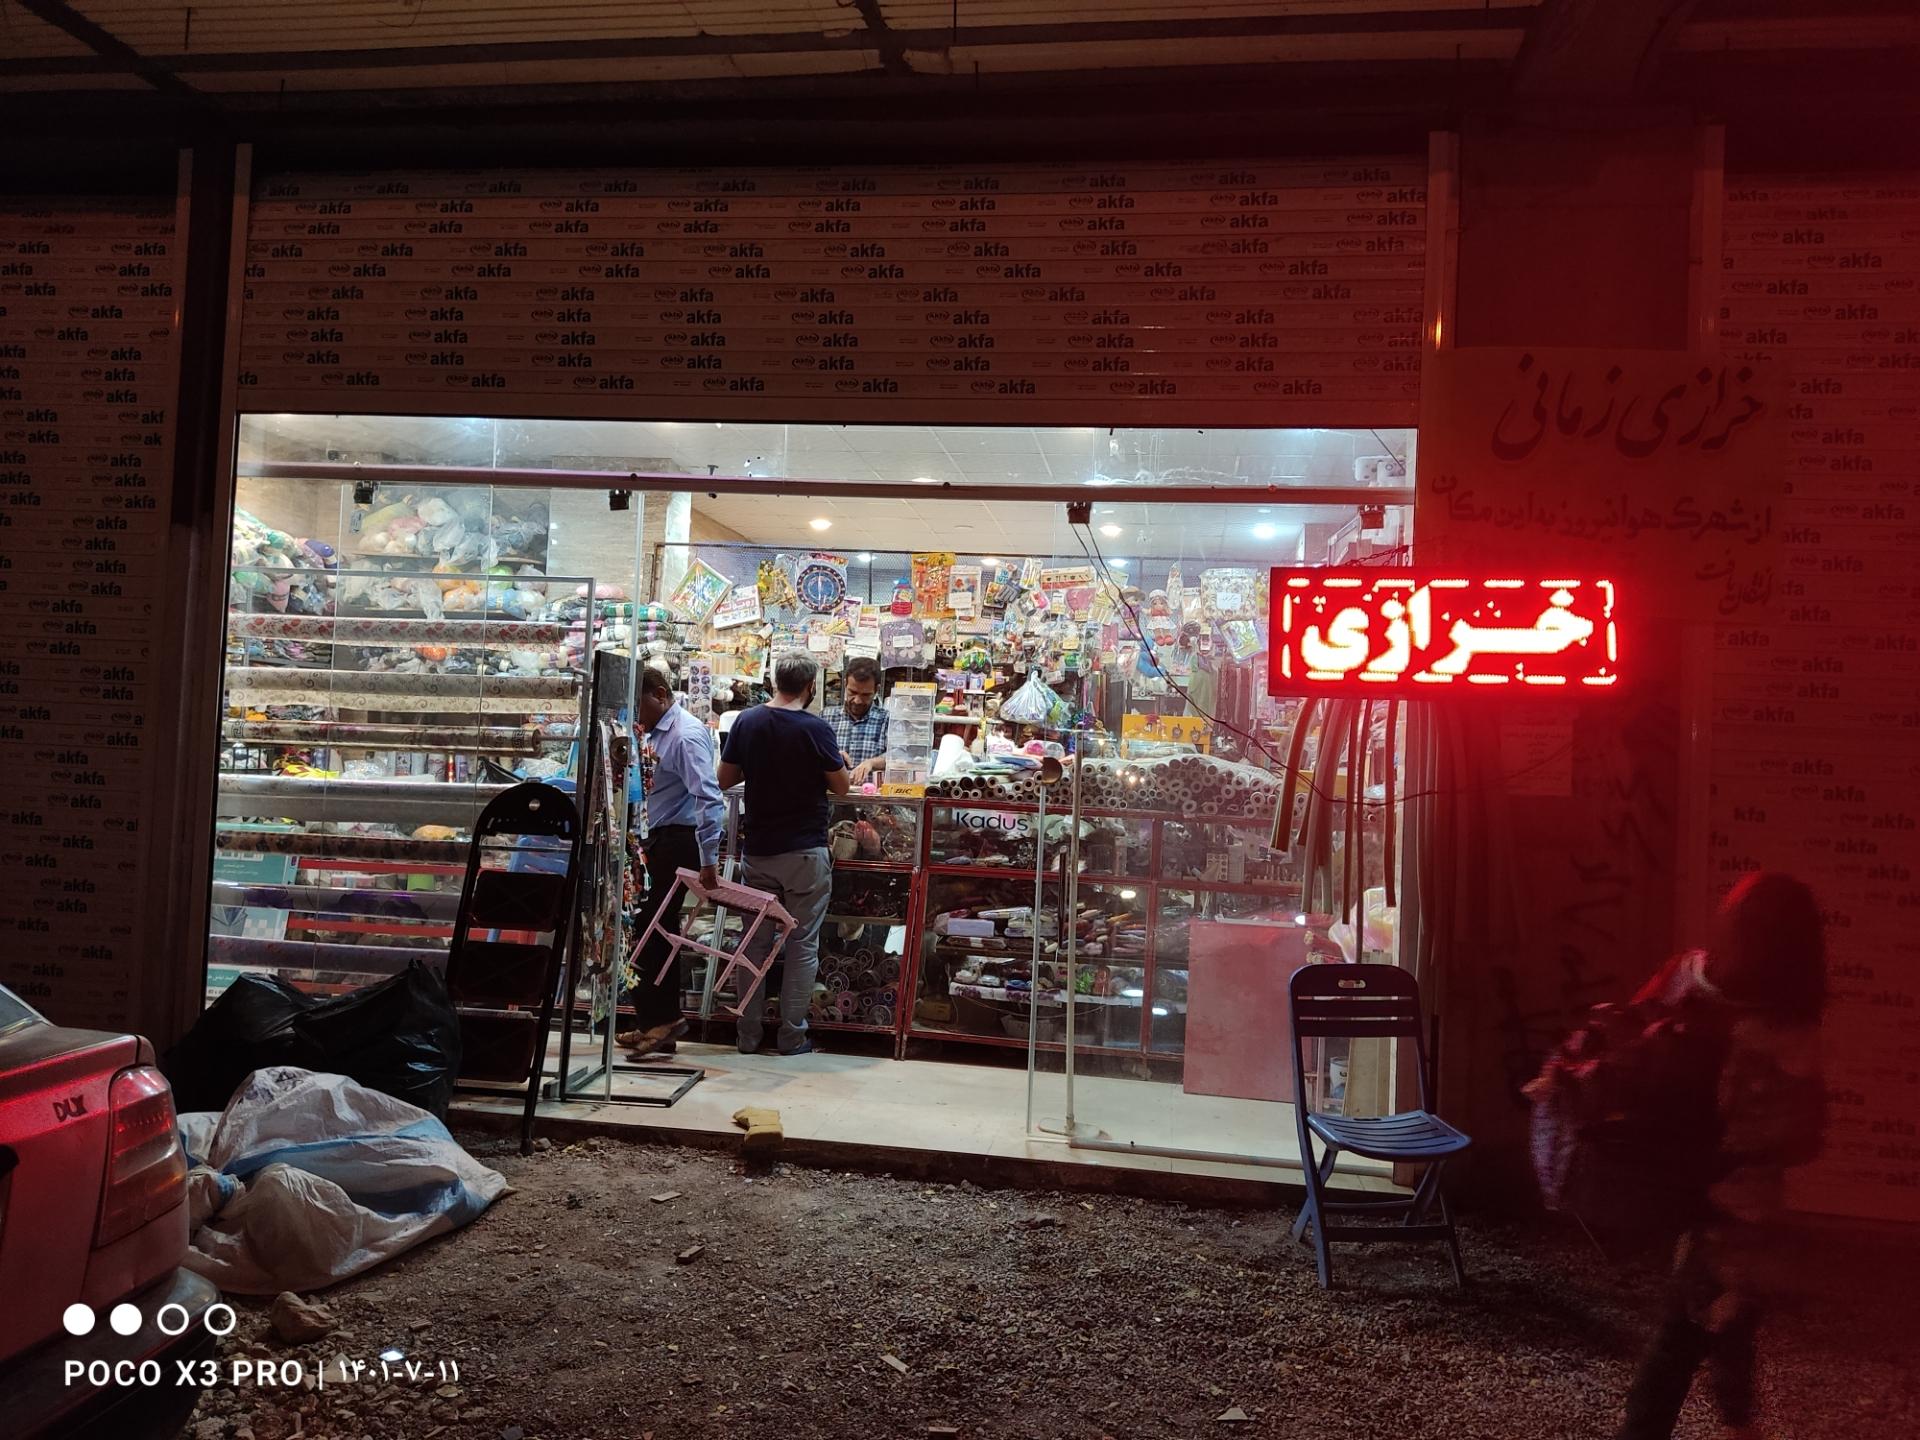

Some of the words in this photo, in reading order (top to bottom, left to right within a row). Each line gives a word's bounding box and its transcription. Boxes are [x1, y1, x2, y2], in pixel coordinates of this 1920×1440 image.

[565, 199, 599, 212] akfa
[694, 199, 728, 212] akfa
[825, 198, 860, 212] akfa
[959, 197, 996, 211] akfa
[1097, 194, 1135, 209] akfa
[1239, 192, 1278, 206] akfa
[319, 201, 351, 214] akfa
[440, 200, 473, 213] akfa
[949, 218, 986, 232] akfa
[1087, 217, 1125, 230] akfa
[1230, 214, 1268, 228] akfa
[1377, 211, 1417, 225] akfa
[308, 222, 340, 234] akfa
[429, 221, 463, 233] akfa
[554, 220, 589, 233] akfa
[683, 220, 720, 233] akfa
[814, 220, 850, 233] akfa
[19, 241, 50, 254] akfa
[134, 243, 166, 255] akfa
[272, 244, 302, 257] akfa
[381, 244, 413, 257] akfa
[495, 242, 527, 256] akfa
[611, 243, 644, 257] akfa
[729, 244, 763, 257] akfa
[850, 243, 885, 258] akfa
[974, 242, 1009, 257] akfa
[1100, 240, 1137, 255] akfa
[1230, 238, 1268, 254] akfa
[1366, 236, 1404, 252] akfa
[2, 263, 33, 276] akfa
[119, 264, 150, 276] akfa
[353, 264, 386, 277] akfa
[477, 264, 511, 277] akfa
[605, 264, 639, 278] akfa
[735, 264, 770, 278] akfa
[868, 264, 904, 279] akfa
[1004, 263, 1041, 278] akfa
[1144, 262, 1182, 277] akfa
[1288, 259, 1328, 275] akfa
[25, 283, 56, 296] akfa
[141, 283, 172, 297] akfa
[332, 287, 363, 300] akfa
[445, 287, 478, 300] akfa
[561, 287, 594, 301] akfa
[680, 289, 714, 302] akfa
[800, 289, 834, 303] akfa
[923, 288, 958, 302] akfa
[1048, 287, 1085, 302] akfa
[1178, 286, 1216, 301] akfa
[1312, 284, 1351, 300] akfa
[91, 306, 123, 319] akfa
[307, 307, 339, 320] akfa
[430, 307, 464, 321] akfa
[557, 308, 591, 322] akfa
[686, 310, 721, 324] akfa
[818, 310, 854, 325] akfa
[953, 310, 989, 325] akfa
[1235, 309, 1274, 324] akfa
[57, 328, 88, 341] akfa
[310, 329, 343, 342] akfa
[434, 329, 468, 343] akfa
[561, 331, 595, 345] akfa
[691, 332, 726, 346] akfa
[822, 333, 858, 347] akfa
[958, 334, 994, 348] akfa
[1096, 333, 1134, 348] akfa
[1239, 332, 1278, 348] akfa
[111, 348, 141, 360] akfa
[306, 351, 339, 364] akfa
[430, 352, 464, 365] akfa
[558, 353, 592, 367] akfa
[687, 355, 722, 369] akfa
[819, 356, 854, 370] akfa
[953, 356, 990, 371] akfa
[1092, 356, 1129, 372] akfa
[1235, 357, 1274, 372] akfa
[104, 369, 135, 381] akfa
[346, 371, 379, 386] akfa
[472, 374, 505, 388] akfa
[599, 375, 634, 389] akfa
[729, 377, 764, 391] akfa
[862, 378, 898, 392] akfa
[998, 379, 1035, 394] akfa
[1138, 379, 1176, 394] akfa
[1282, 379, 1322, 395] akfa
[106, 390, 137, 403] akfa
[1491, 352, 1623, 461] زمانی
[1615, 366, 1763, 458] خرازی
[26, 409, 57, 422] akfa
[28, 431, 60, 444] akfa
[110, 454, 141, 467] akfa
[0, 472, 31, 485] akfa
[115, 474, 146, 487] akfa
[10, 493, 41, 506] akfa
[125, 496, 156, 509] akfa
[96, 517, 127, 530] akfa
[1744, 505, 1772, 544] از
[85, 538, 115, 551] akfa
[96, 561, 126, 574] akfa
[91, 582, 122, 596] akfa
[52, 600, 82, 613] akfa
[65, 622, 97, 635] akfa
[1301, 585, 1594, 675] خرازی
[49, 642, 80, 655] akfa
[103, 668, 134, 681] akfa
[102, 687, 133, 700] akfa
[20, 707, 50, 720] akfa
[107, 732, 138, 746] akfa
[57, 751, 88, 764] akfa
[74, 772, 105, 785] akfa
[70, 796, 101, 809] akfa
[12, 812, 42, 825] akfa
[955, 811, 1029, 831] Kadus
[63, 836, 94, 849] akfa
[25, 855, 57, 868] akfa
[63, 879, 96, 893] akfa
[56, 900, 87, 913] akfa
